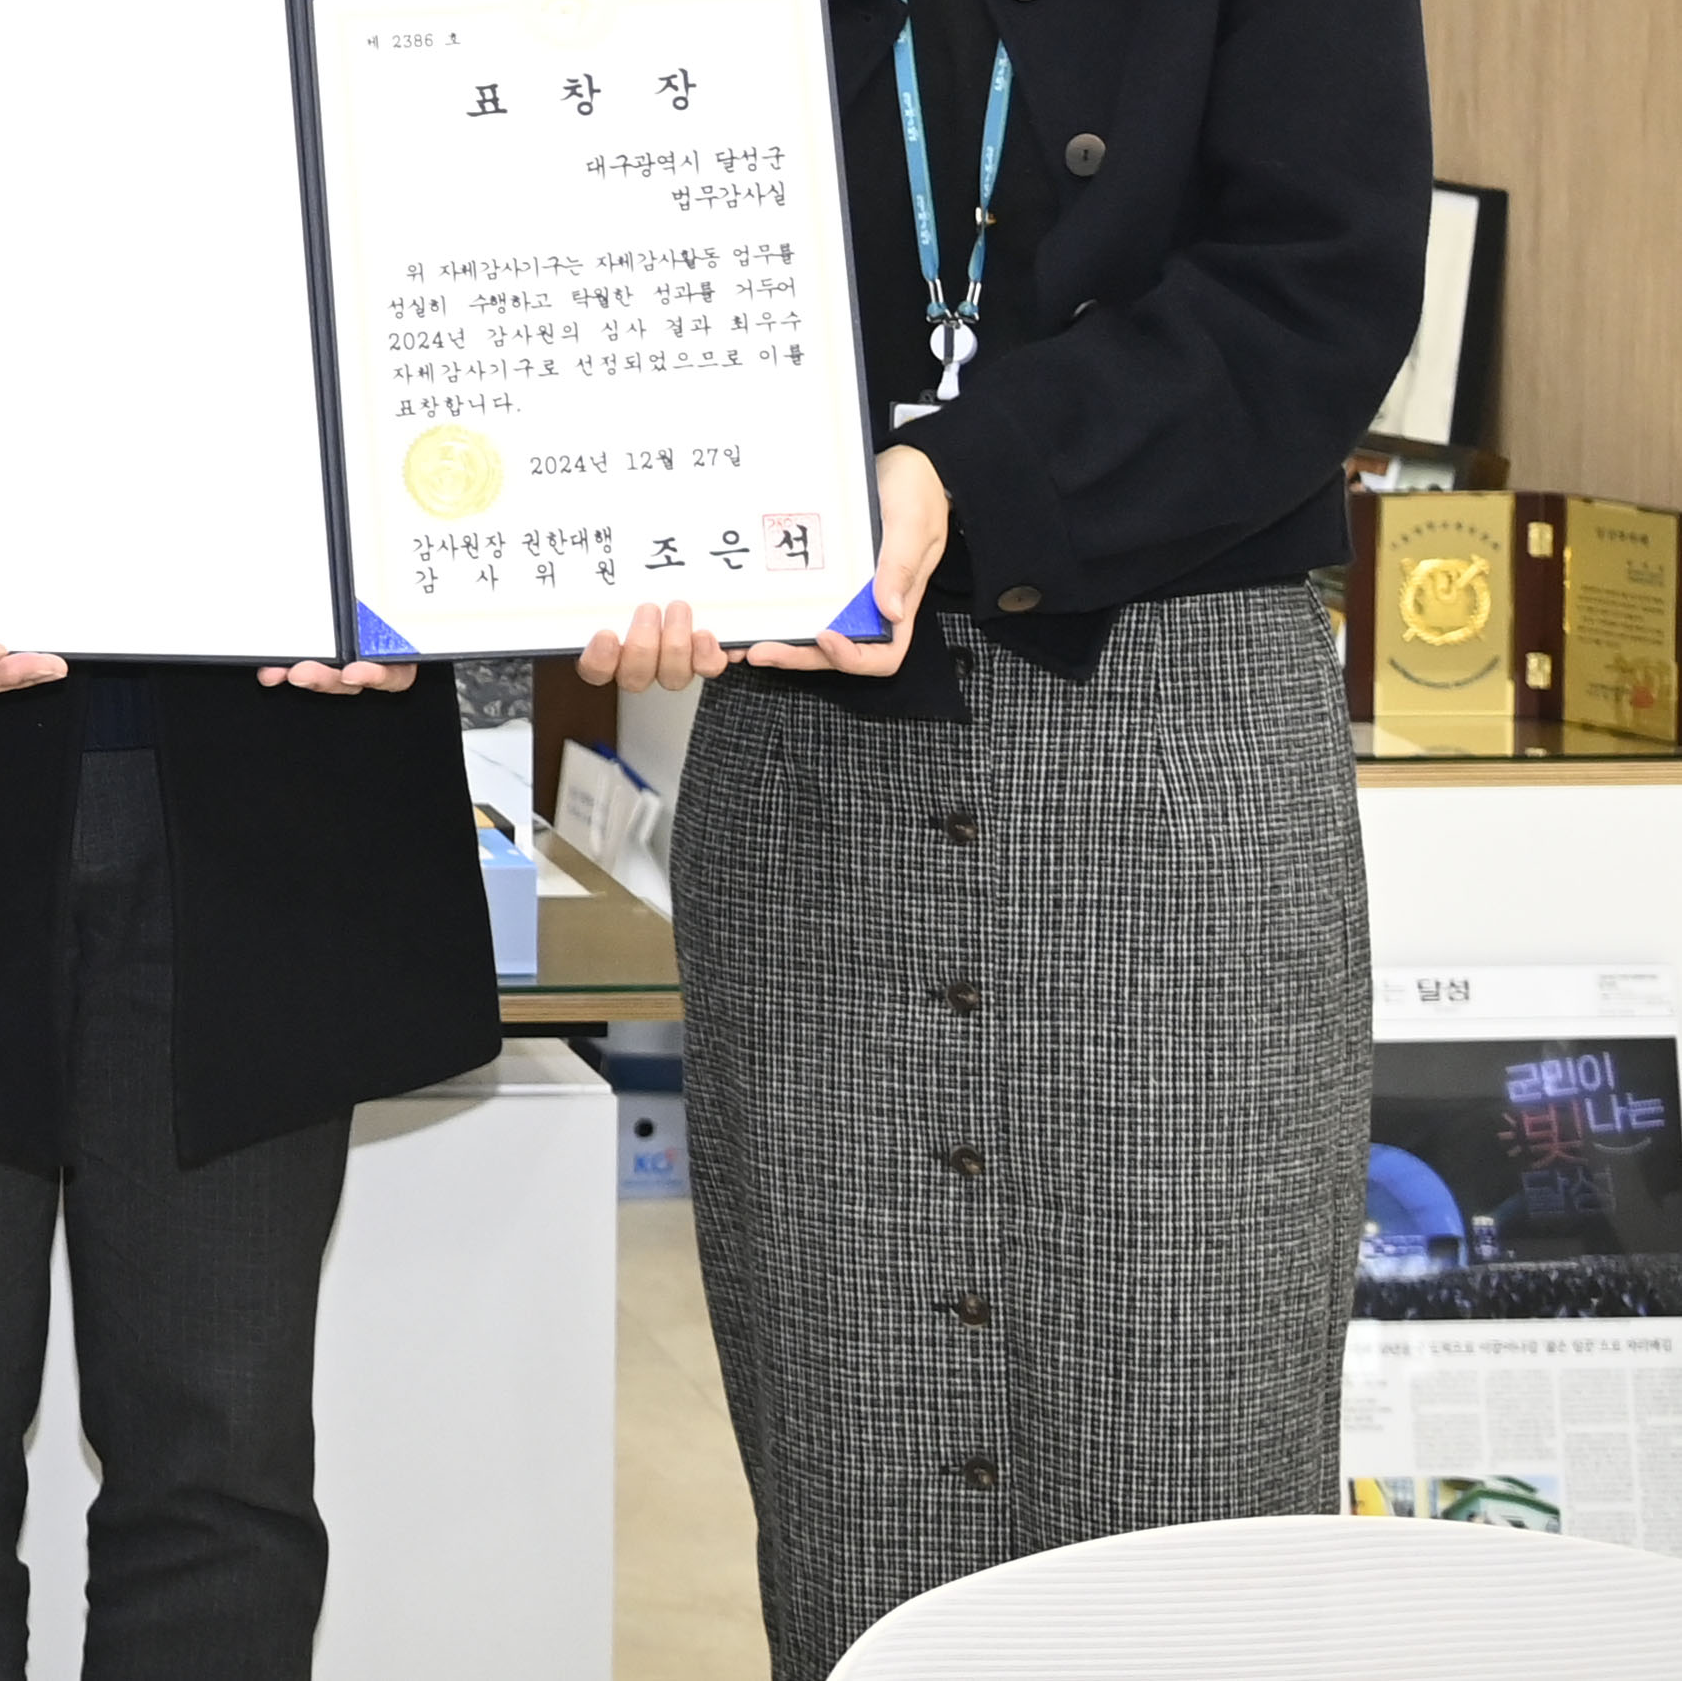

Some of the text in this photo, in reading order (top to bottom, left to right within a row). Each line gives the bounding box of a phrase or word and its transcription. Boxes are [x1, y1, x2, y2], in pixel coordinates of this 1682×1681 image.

[586, 145, 786, 178] 대구광역시 달성군
[671, 180, 786, 212] 법무감사실
[406, 242, 795, 283] 위 자체감사기구는 자체감사활동 업무를
[389, 276, 796, 320] 성실히 수행하고 탁월한 성과를 거두어
[388, 311, 802, 351] 2024년 감사원의 심사 결과 최우수
[394, 343, 805, 384] 자체감사기구로 선정되었으므로 이를
[395, 392, 521, 419] 표창합니다.
[530, 444, 741, 475] 2024년 12월 27일
[413, 531, 506, 562] 감사원장
[521, 526, 612, 557] 권한대행
[1416, 977, 1472, 1004] 달성
[1505, 1051, 1615, 1103] 군민이
